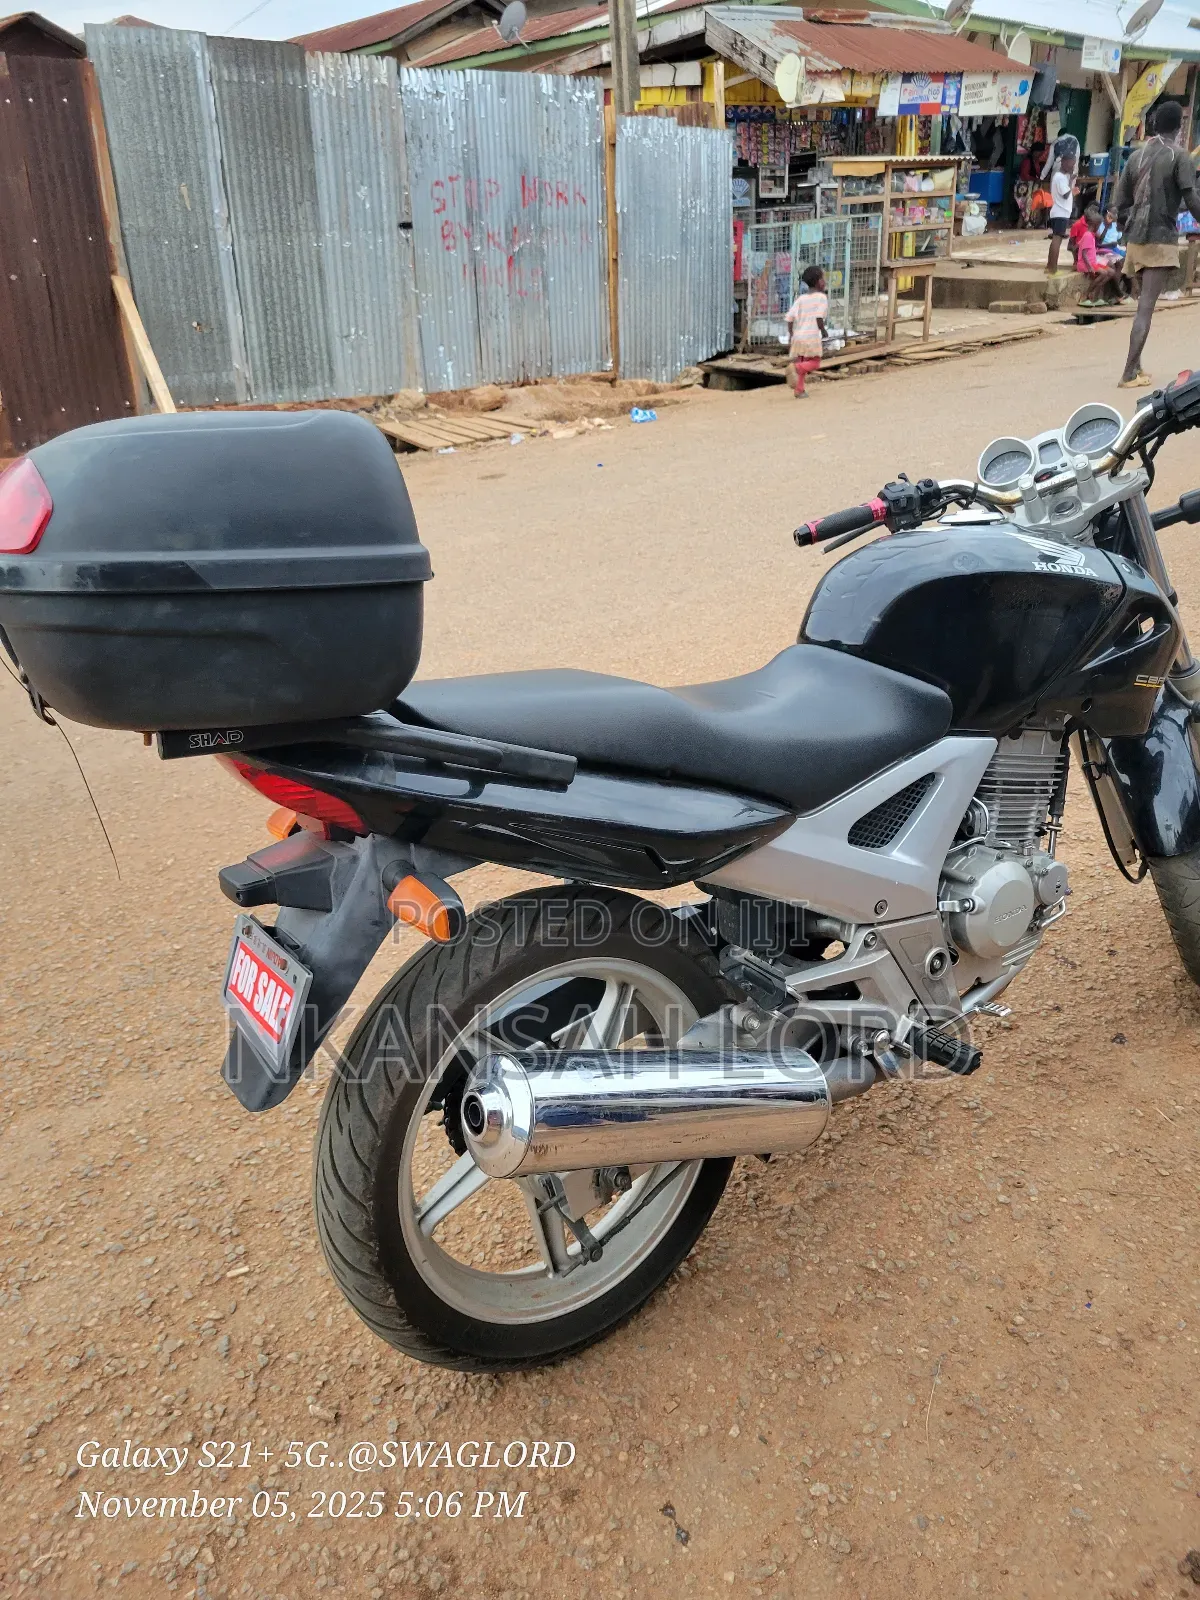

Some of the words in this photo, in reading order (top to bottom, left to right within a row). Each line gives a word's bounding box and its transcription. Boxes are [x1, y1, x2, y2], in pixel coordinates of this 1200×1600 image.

[430, 174, 501, 215] STOP
[520, 174, 588, 209] WORK
[440, 219, 472, 252] BY
[1031, 561, 1099, 577] HONDA
[189, 729, 244, 749] SHAD
[231, 948, 259, 1003] FOR
